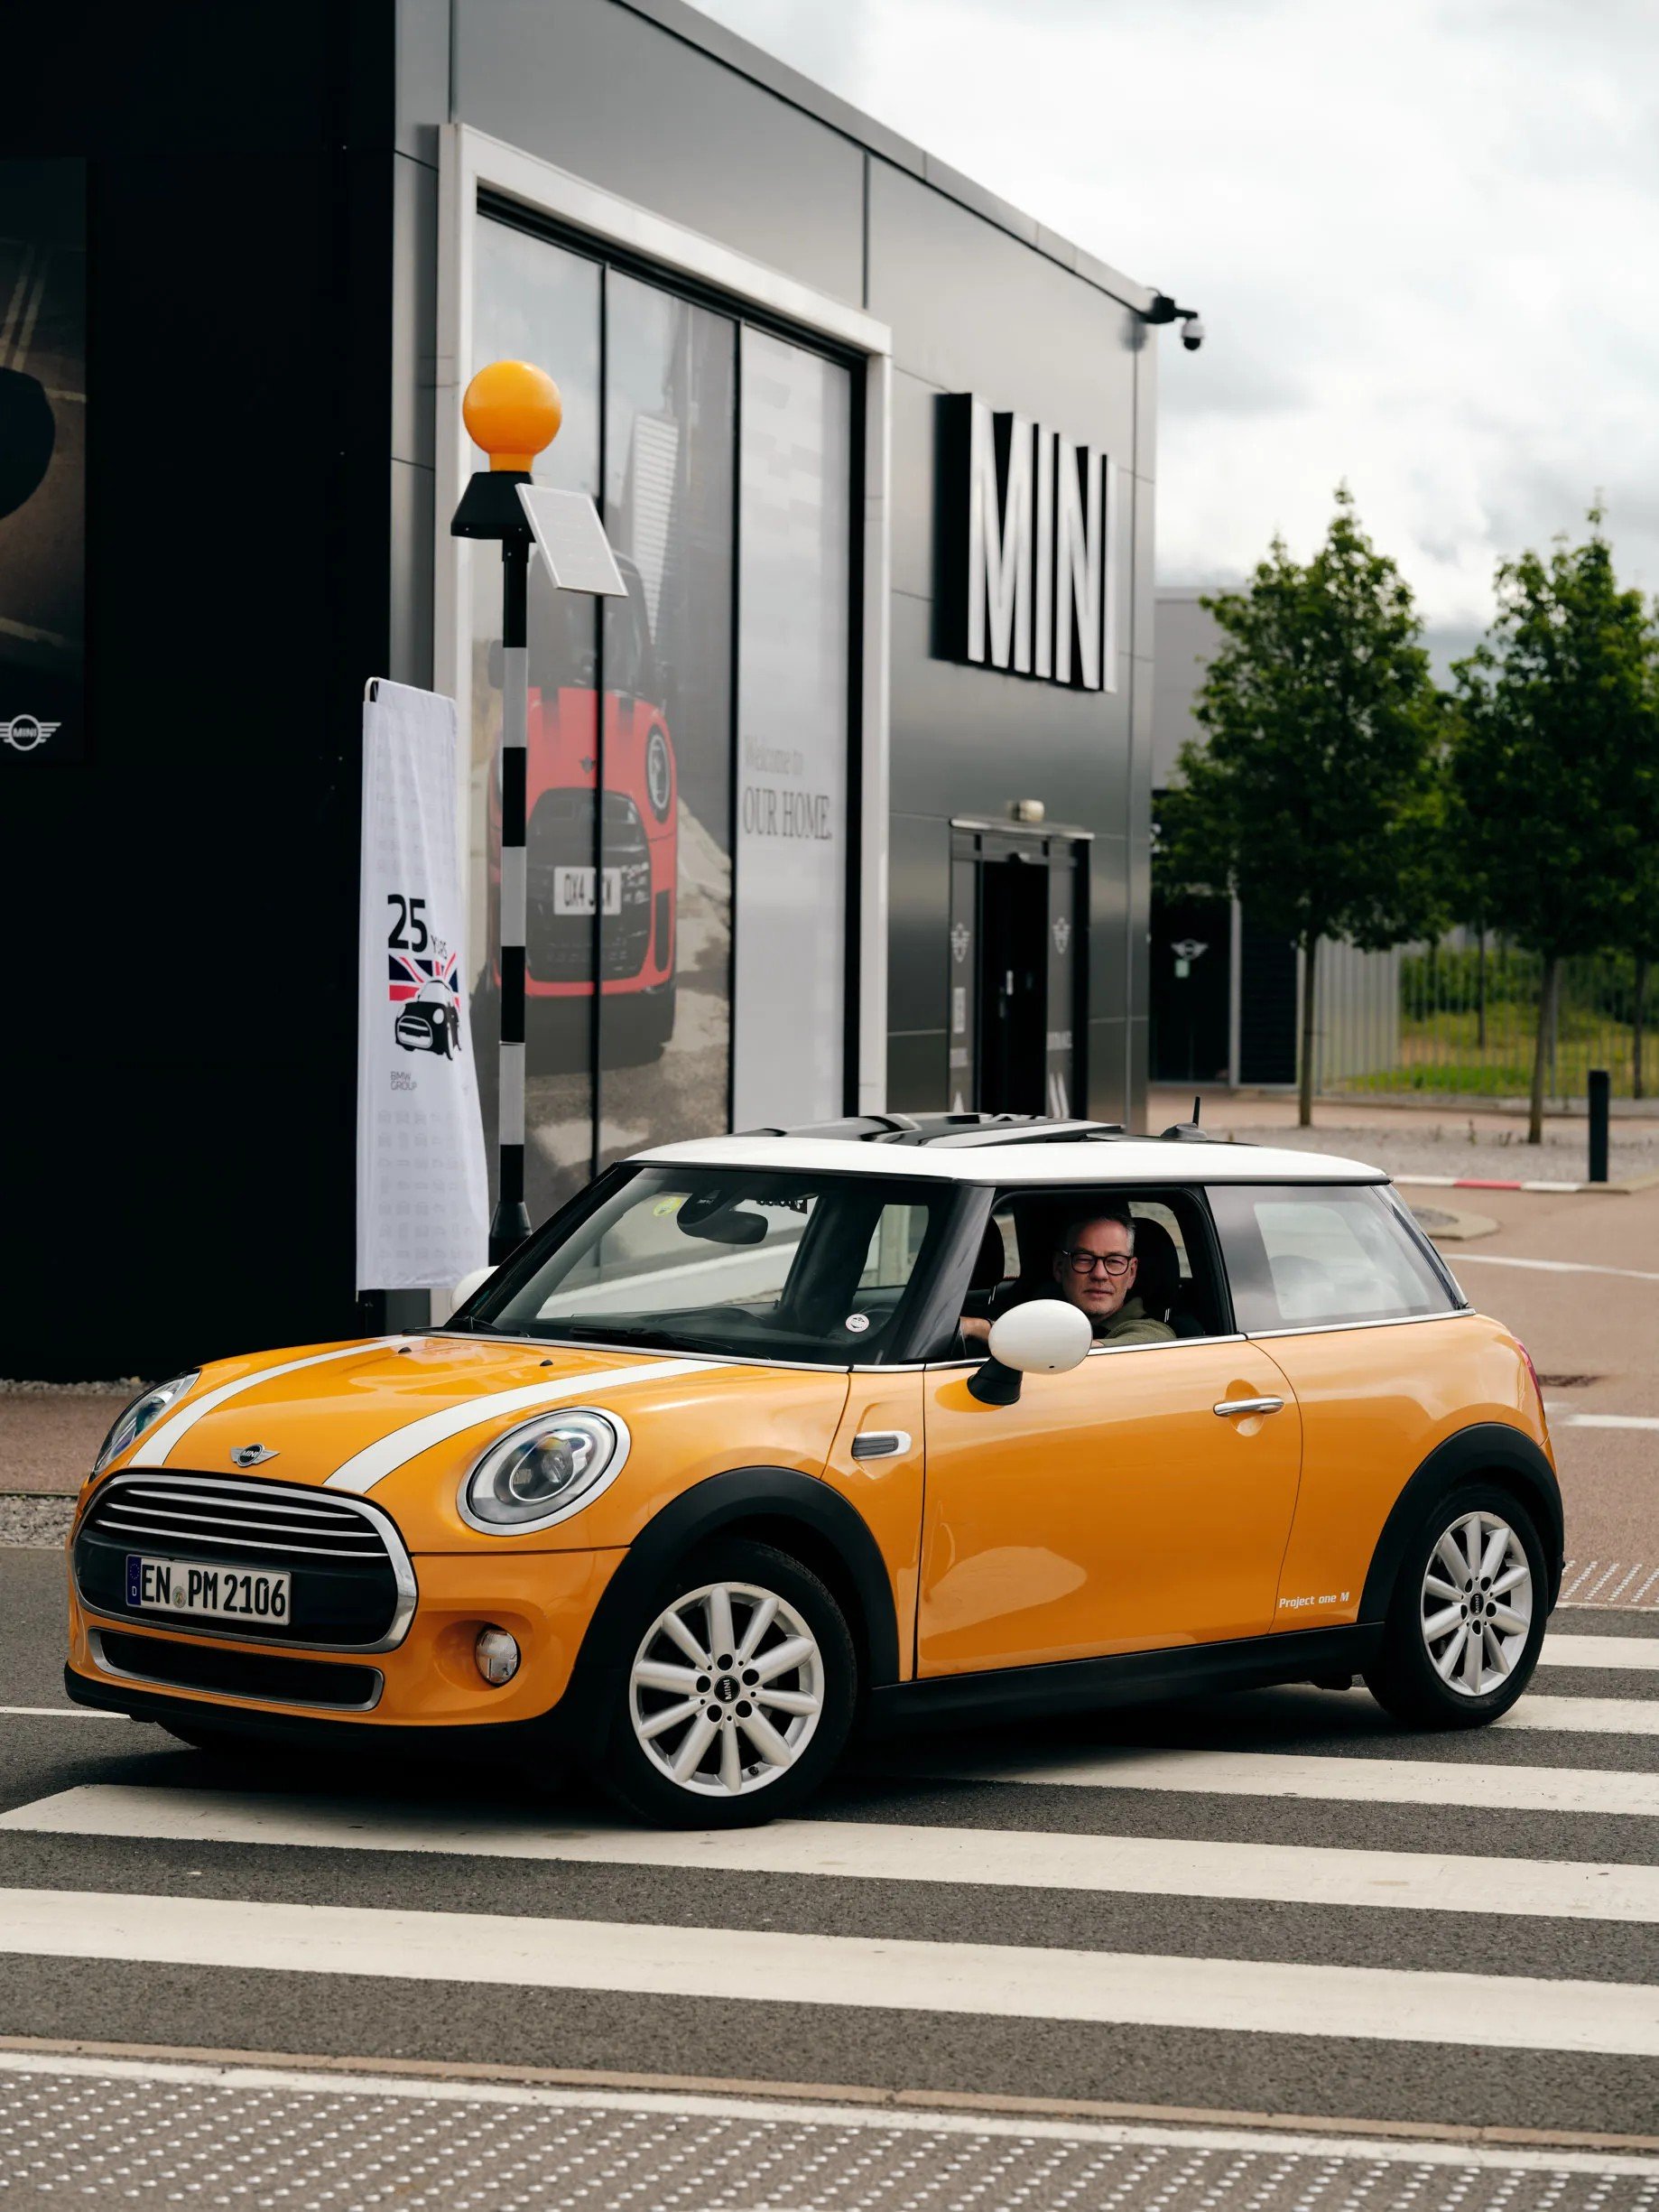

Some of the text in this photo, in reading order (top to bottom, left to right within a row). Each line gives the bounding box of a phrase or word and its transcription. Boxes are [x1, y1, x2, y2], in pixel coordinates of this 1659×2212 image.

[967, 395, 1118, 693] MINI
[13, 727, 38, 739] MINI
[743, 785, 777, 835] OUR
[387, 893, 428, 953] 25
[390, 1070, 412, 1082] BMW
[390, 1080, 418, 1092] GROUP
[132, 1585, 137, 1597] D
[142, 1564, 286, 1617] EN PM 2106
[1279, 1591, 1350, 1610] Project one M
[723, 1679, 732, 1700] MINI
